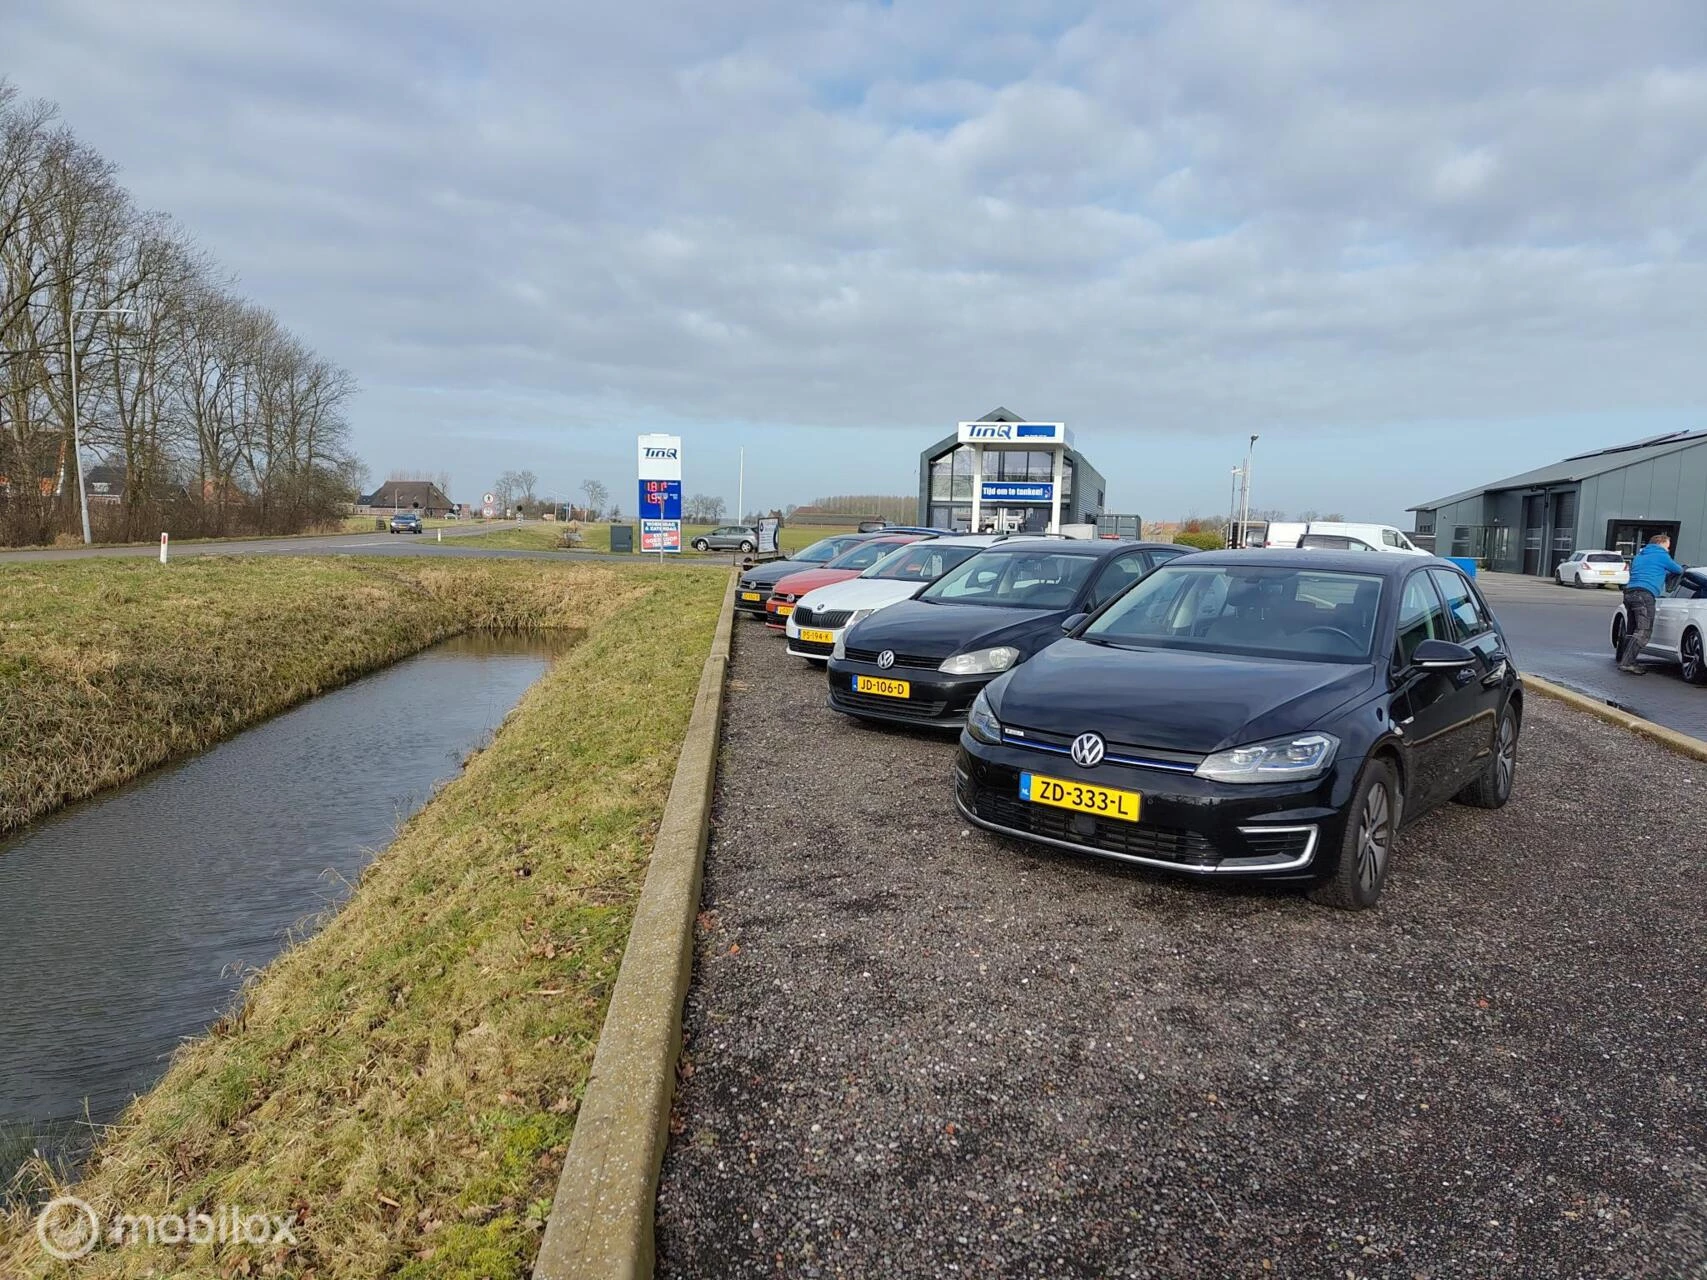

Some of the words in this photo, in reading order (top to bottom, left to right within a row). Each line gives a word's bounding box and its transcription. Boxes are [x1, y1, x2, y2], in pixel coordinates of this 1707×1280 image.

[966, 425, 1012, 440] TinQ
[642, 447, 678, 460] TinQ
[861, 679, 905, 695] JD-106-D
[1040, 781, 1129, 815] ZD-333-L
